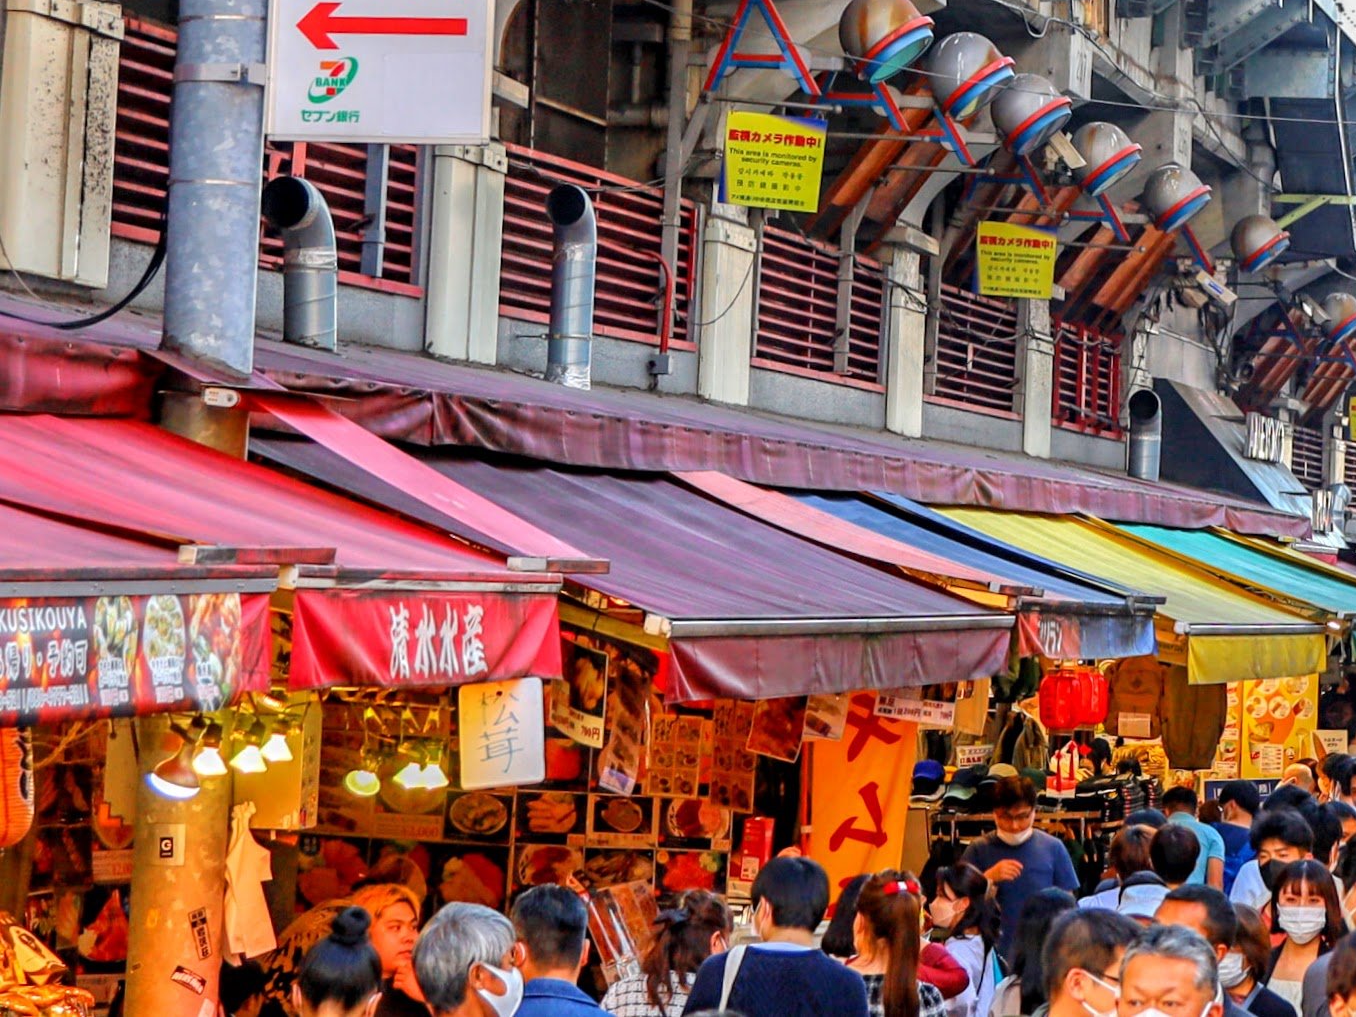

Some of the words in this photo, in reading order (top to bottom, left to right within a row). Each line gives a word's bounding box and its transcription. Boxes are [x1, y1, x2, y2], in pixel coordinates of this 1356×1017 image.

[315, 77, 347, 88] BANK
[300, 109, 360, 123] セブン銀行
[390, 601, 488, 679] 清水水産
[478, 691, 524, 774] 松茸
